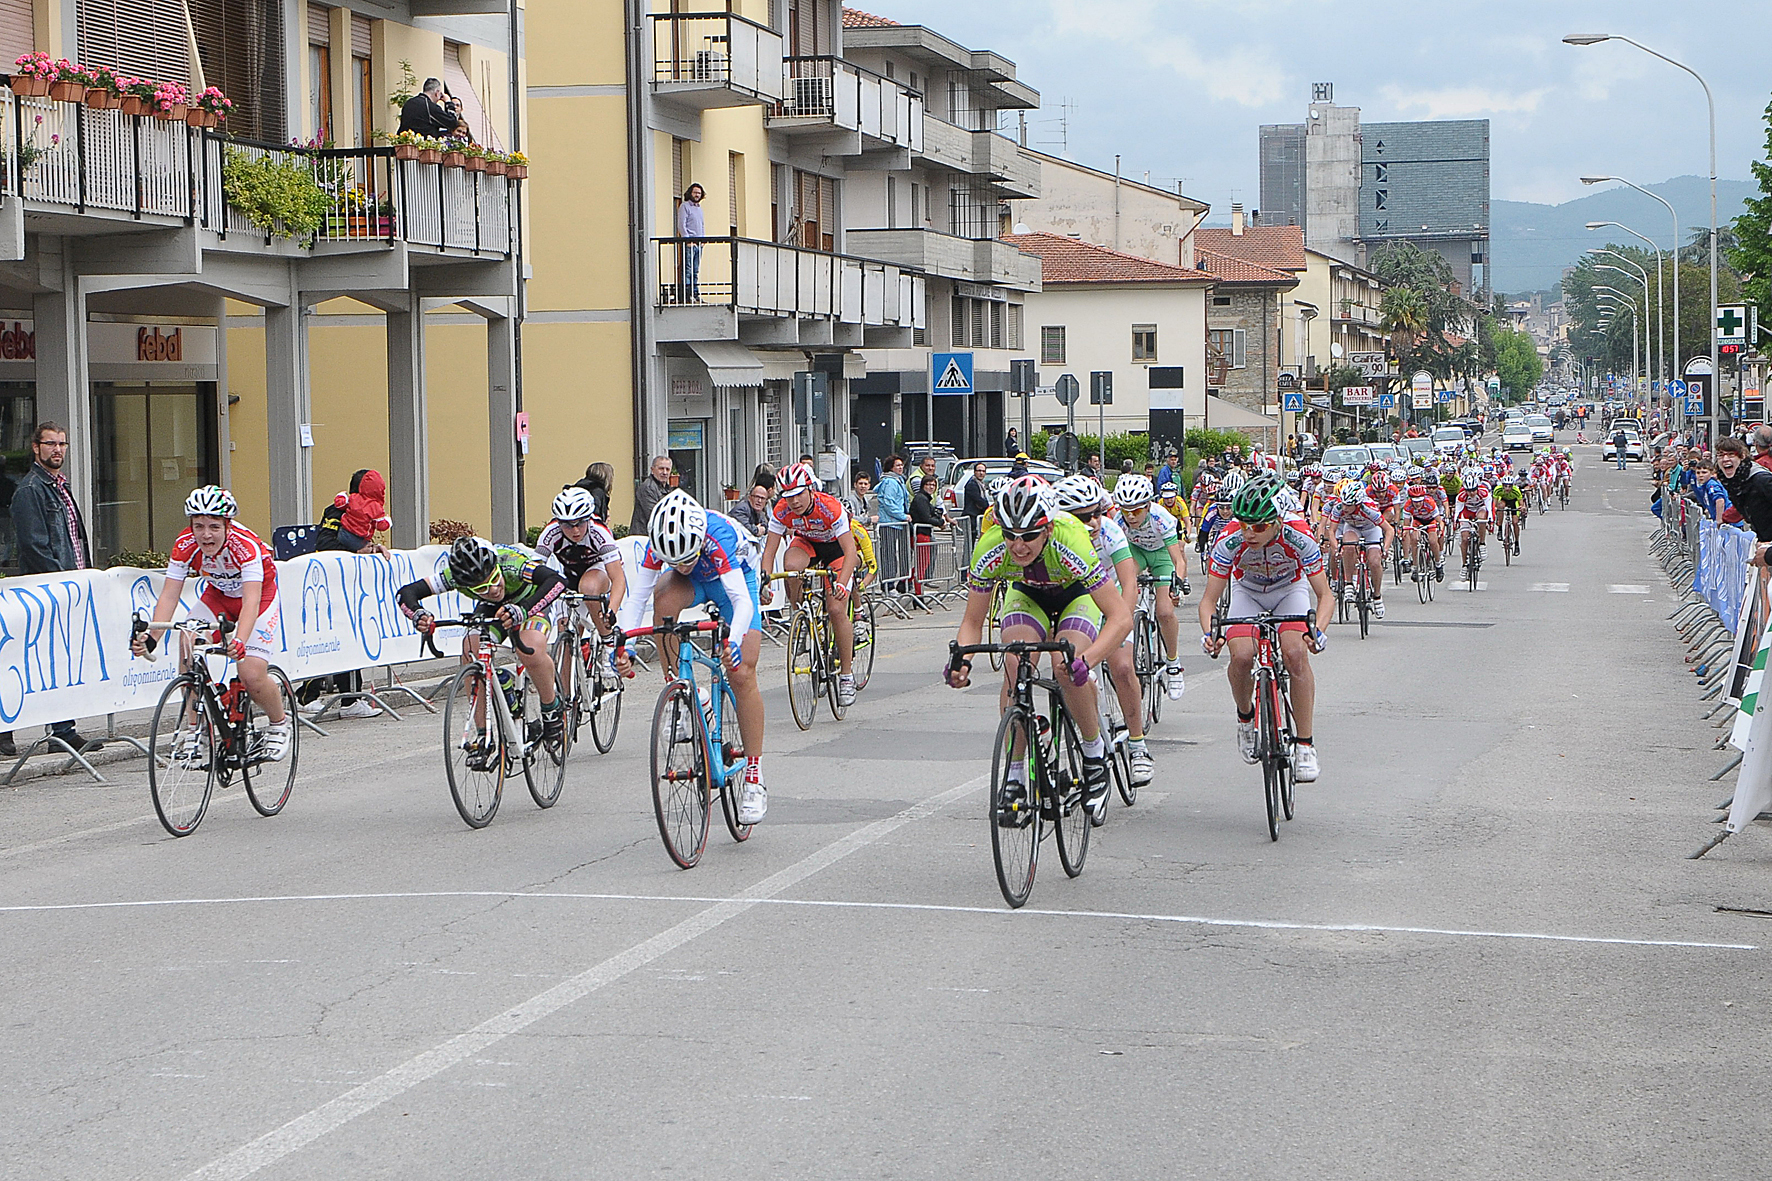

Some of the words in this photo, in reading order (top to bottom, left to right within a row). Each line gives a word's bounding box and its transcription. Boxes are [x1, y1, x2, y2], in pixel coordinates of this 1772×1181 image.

[138, 326, 182, 361] febal
[1371, 363, 1383, 375] 90
[672, 380, 686, 395] PEPE
[1347, 388, 1368, 396] BAR
[1276, 493, 1291, 510] 82
[688, 509, 705, 531] 131
[230, 535, 252, 559] Hotpoint
[296, 636, 341, 664] oligominerale
[122, 662, 176, 695] oligominerale
